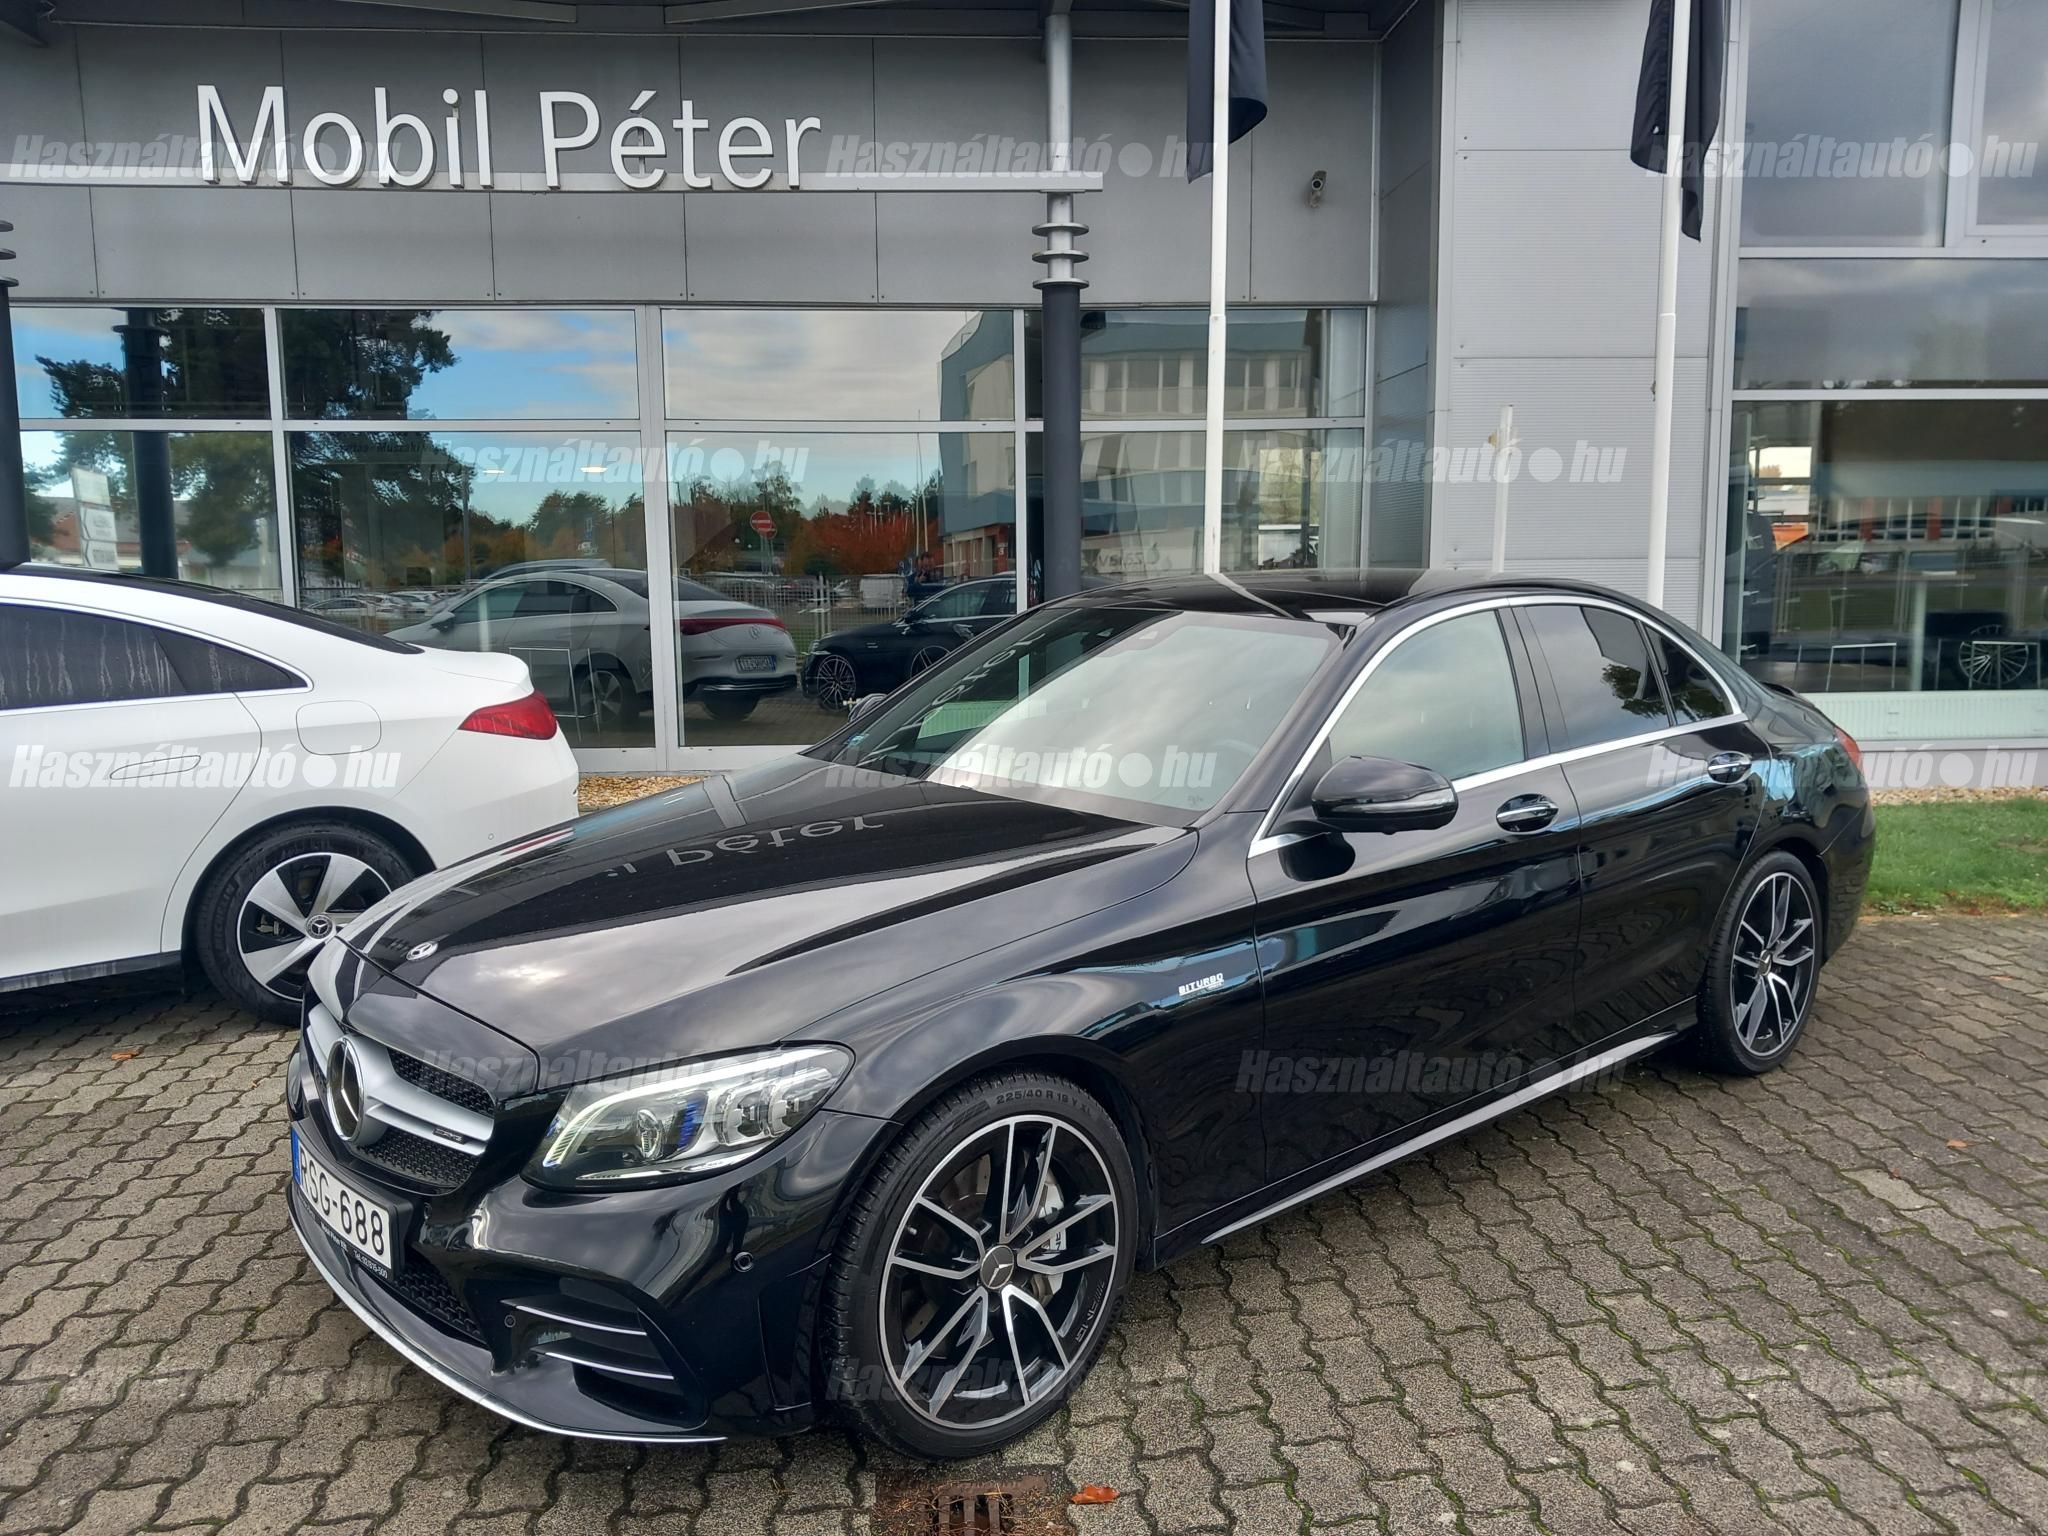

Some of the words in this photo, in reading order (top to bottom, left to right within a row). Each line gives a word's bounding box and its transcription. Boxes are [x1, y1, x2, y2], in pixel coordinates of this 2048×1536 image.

[197, 84, 495, 188] Mobil
[539, 90, 822, 191] Péter
[1178, 973, 1224, 994] BITURBO
[996, 1089, 1042, 1105] 225/40
[1046, 1090, 1054, 1099] R
[300, 1147, 385, 1256] RSG-688
